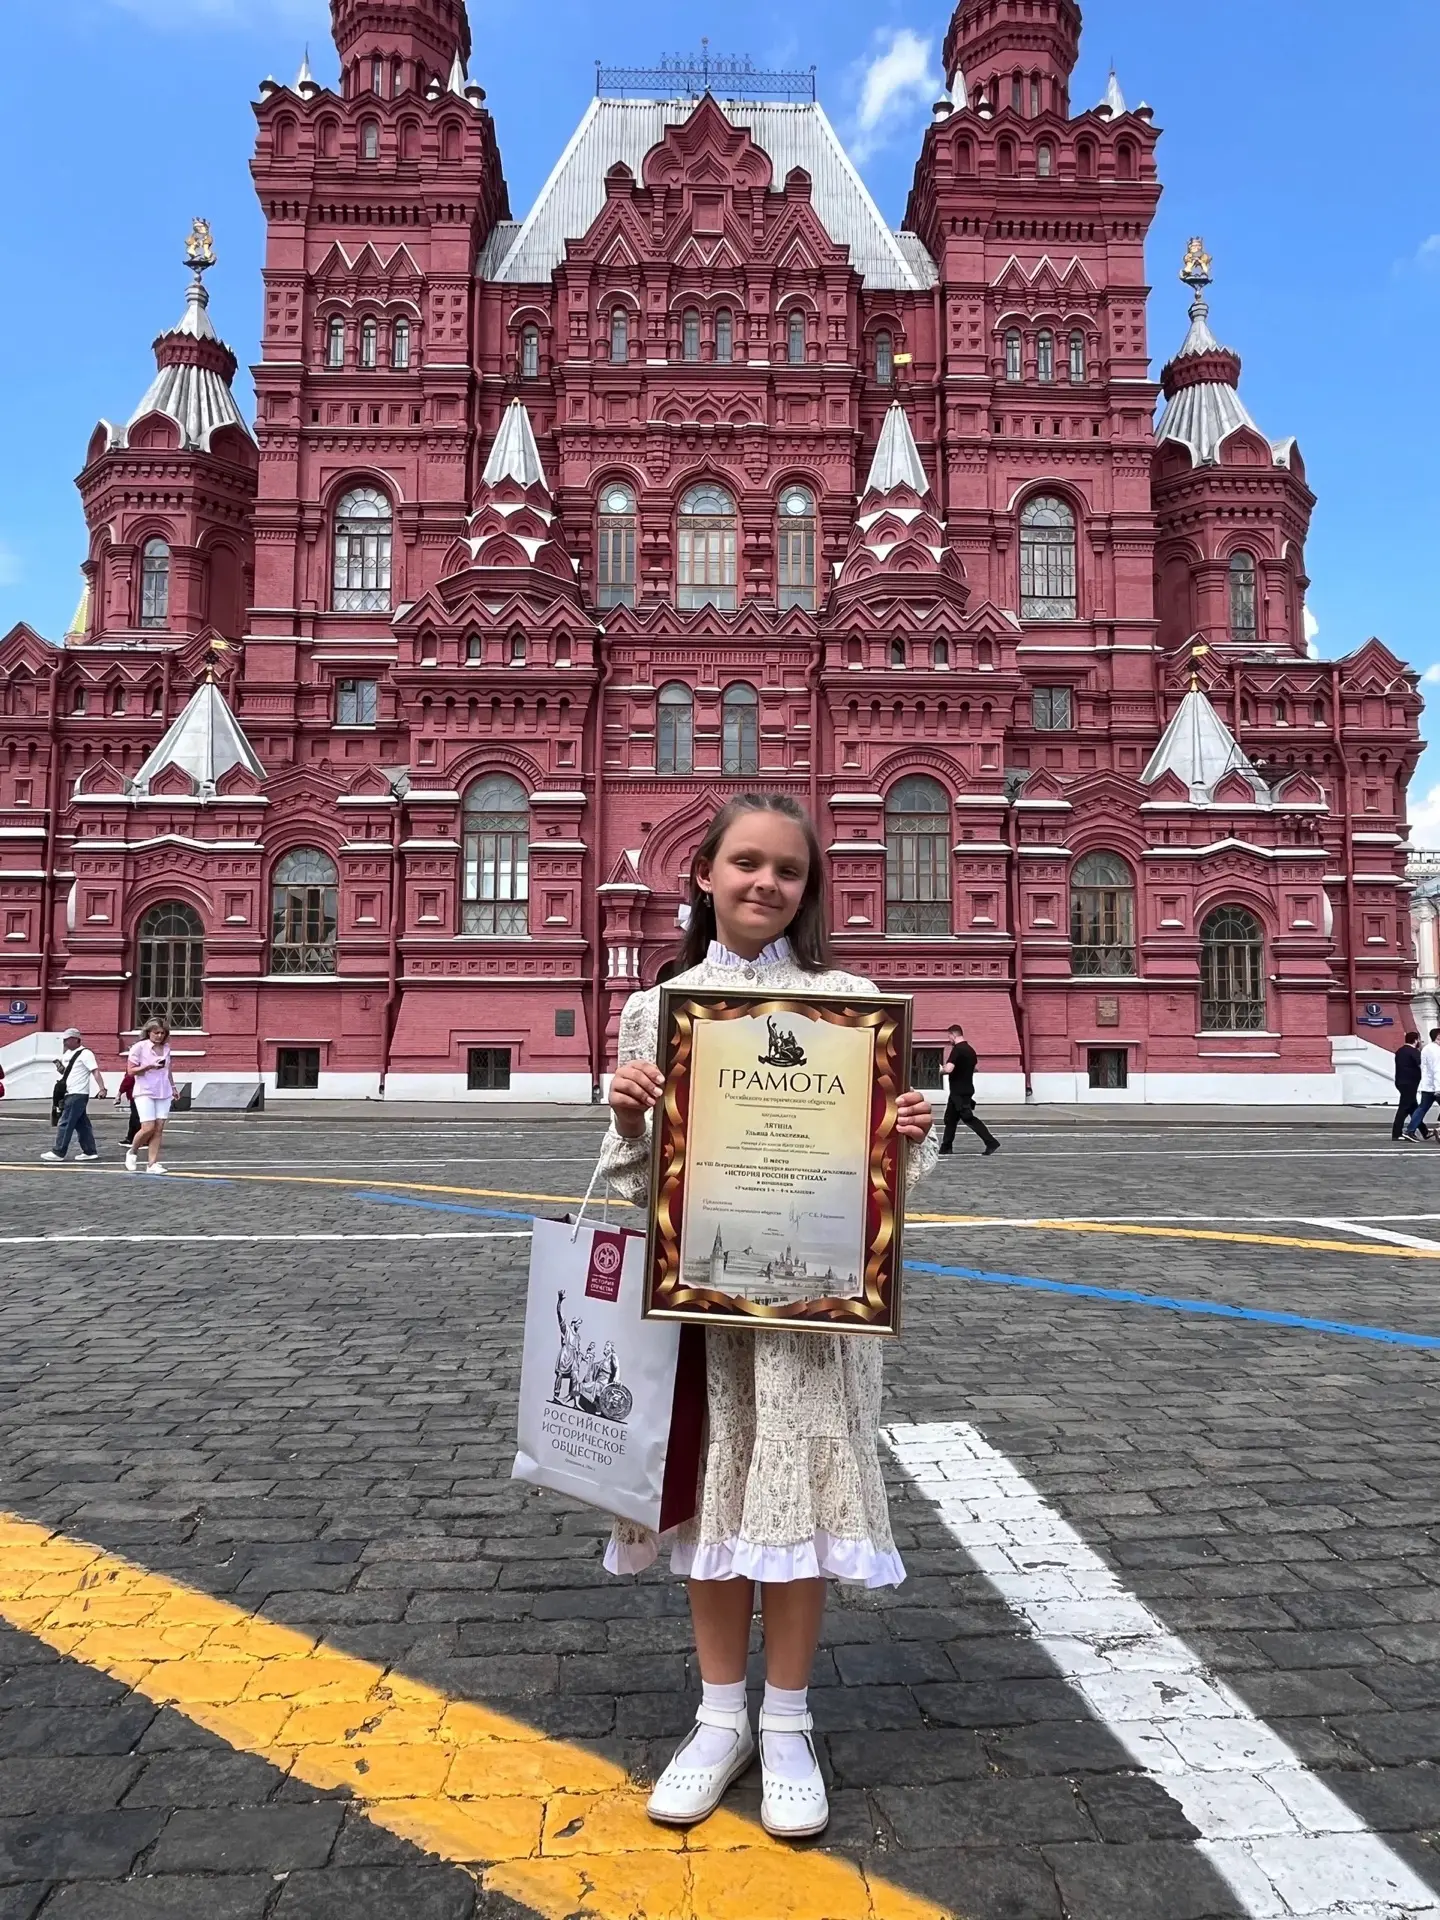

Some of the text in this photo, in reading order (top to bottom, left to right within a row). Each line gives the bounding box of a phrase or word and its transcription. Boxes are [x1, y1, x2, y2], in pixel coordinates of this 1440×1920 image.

[719, 1068, 845, 1095] ГРАМОТА
[761, 1172, 789, 1180] РОССИИ
[542, 1421, 626, 1455] ИСТОРИЧЕСКОЕ
[543, 1407, 628, 1441] РОССИЙСКОЕ
[551, 1438, 612, 1466] ОБЩЕСТВО
